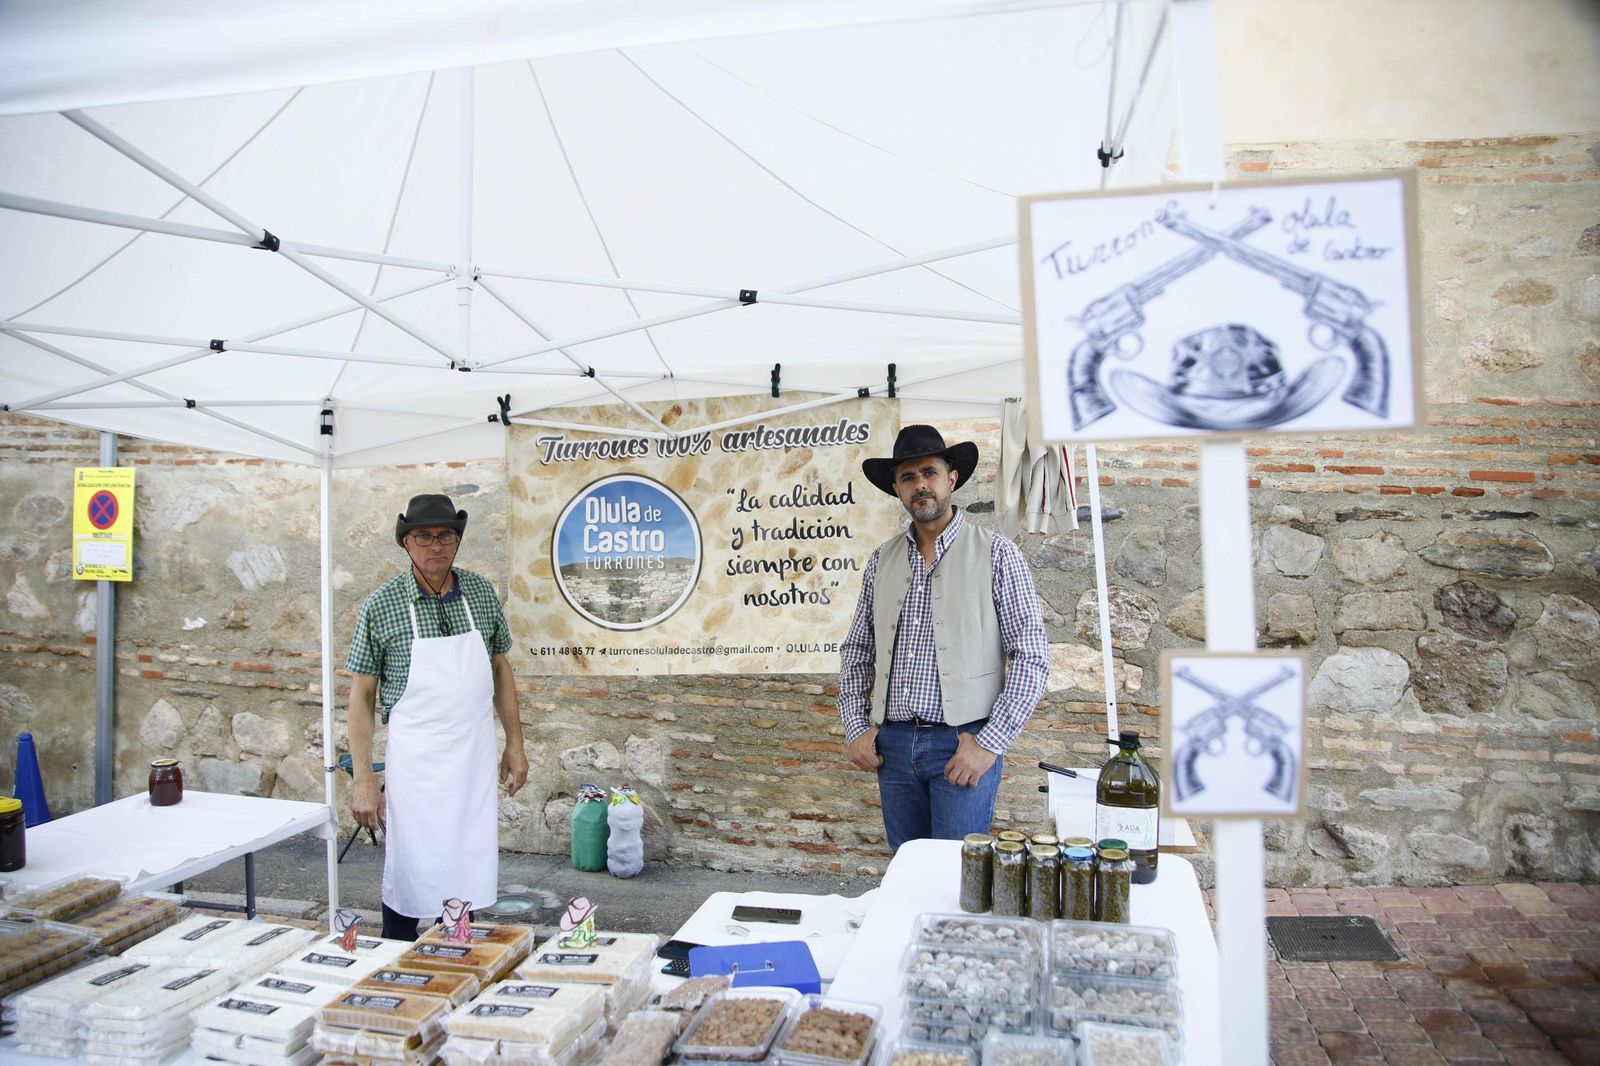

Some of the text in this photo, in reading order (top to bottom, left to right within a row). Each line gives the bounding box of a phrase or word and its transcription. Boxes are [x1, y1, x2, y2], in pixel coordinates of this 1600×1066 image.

[536, 418, 870, 465] Turrones 100% artesanales
[769, 481, 855, 508] calidad
[585, 496, 662, 524] Olula de
[583, 524, 665, 553] Castro
[731, 517, 853, 551] y tradición
[584, 555, 665, 570] TURRONES
[726, 555, 860, 581] siempre con
[540, 647, 556, 656] 611
[559, 647, 570, 656] 48
[585, 646, 596, 655] 77
[609, 644, 774, 656] turronesoluladecastro@gmail.com
[786, 643, 820, 653] OLULA
[824, 643, 838, 652] DE
